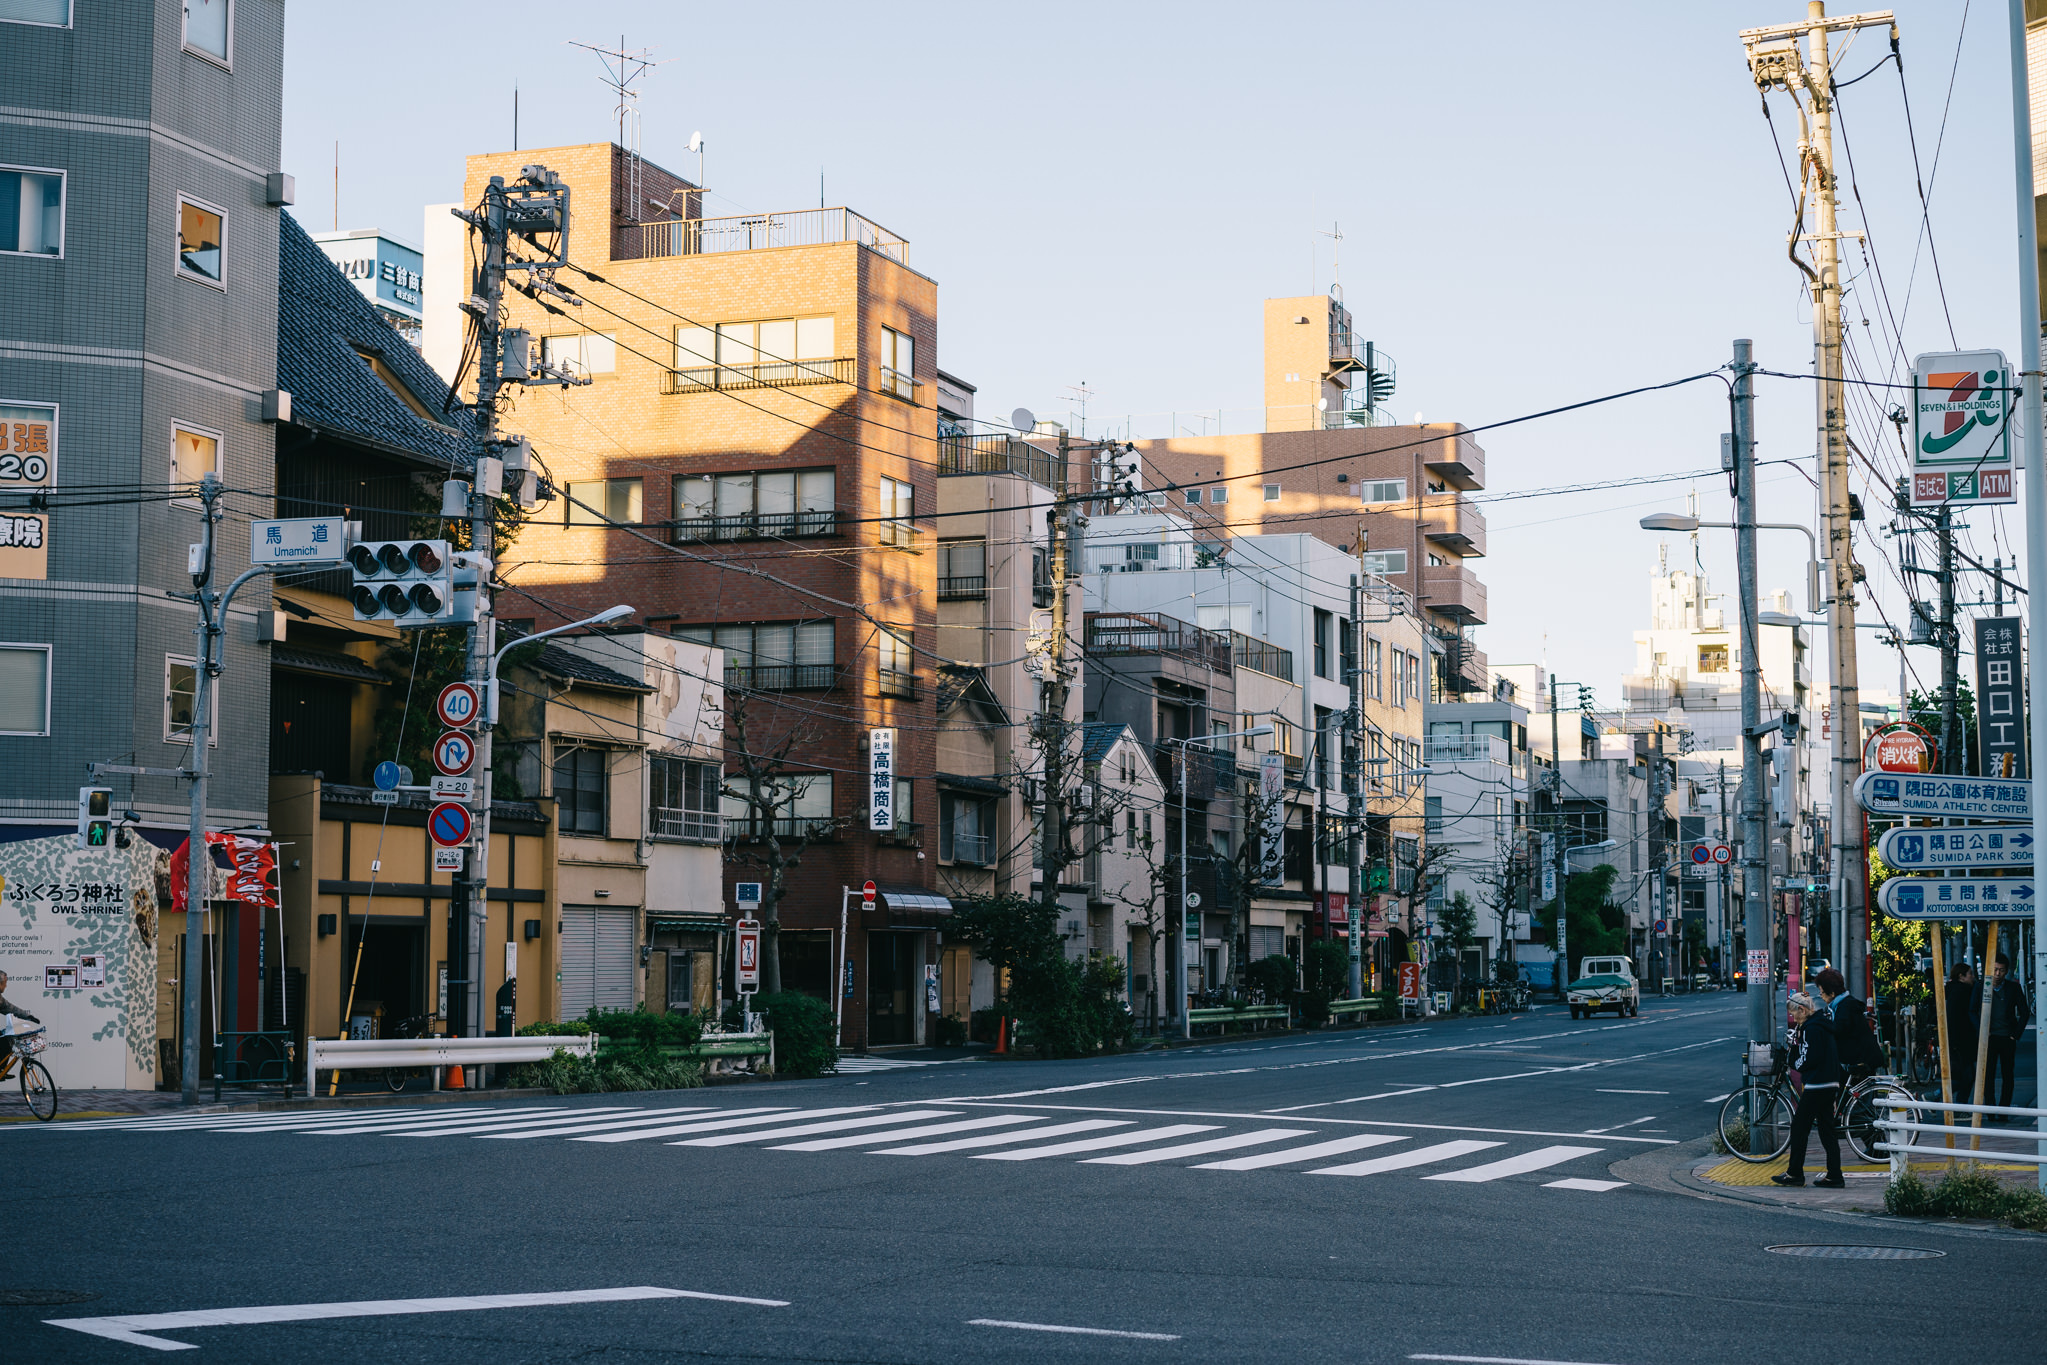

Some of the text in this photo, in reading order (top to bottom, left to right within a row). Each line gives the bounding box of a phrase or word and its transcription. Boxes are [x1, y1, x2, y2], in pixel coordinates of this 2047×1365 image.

[383, 261, 423, 292] 三鈴商
[1958, 400, 2000, 410] HOLDINGS
[1917, 477, 1945, 497] たばこ
[1954, 475, 1973, 496] 酒
[1982, 474, 2010, 494] ATM
[274, 545, 318, 557] Umamichi
[446, 695, 470, 715] 40
[873, 751, 890, 826] 高橋商会
[1905, 780, 2028, 803] 隅田公園体育施設
[1902, 799, 1939, 809] SUMIDA
[1943, 801, 1987, 812] ATHLETIC
[1991, 803, 2028, 814] CENTER
[1930, 833, 2003, 850] 隅田公園
[1716, 850, 1729, 860] 40
[1930, 853, 1972, 863] SUMIDA
[1976, 851, 2004, 861] PARK
[9, 882, 124, 903] ふくろう神社
[1938, 884, 1998, 901] 言問橋
[51, 906, 123, 914] OWL SHRINE
[1926, 903, 1980, 913] KOTOTOIBASHI
[1982, 903, 2008, 912] BRIDGE
